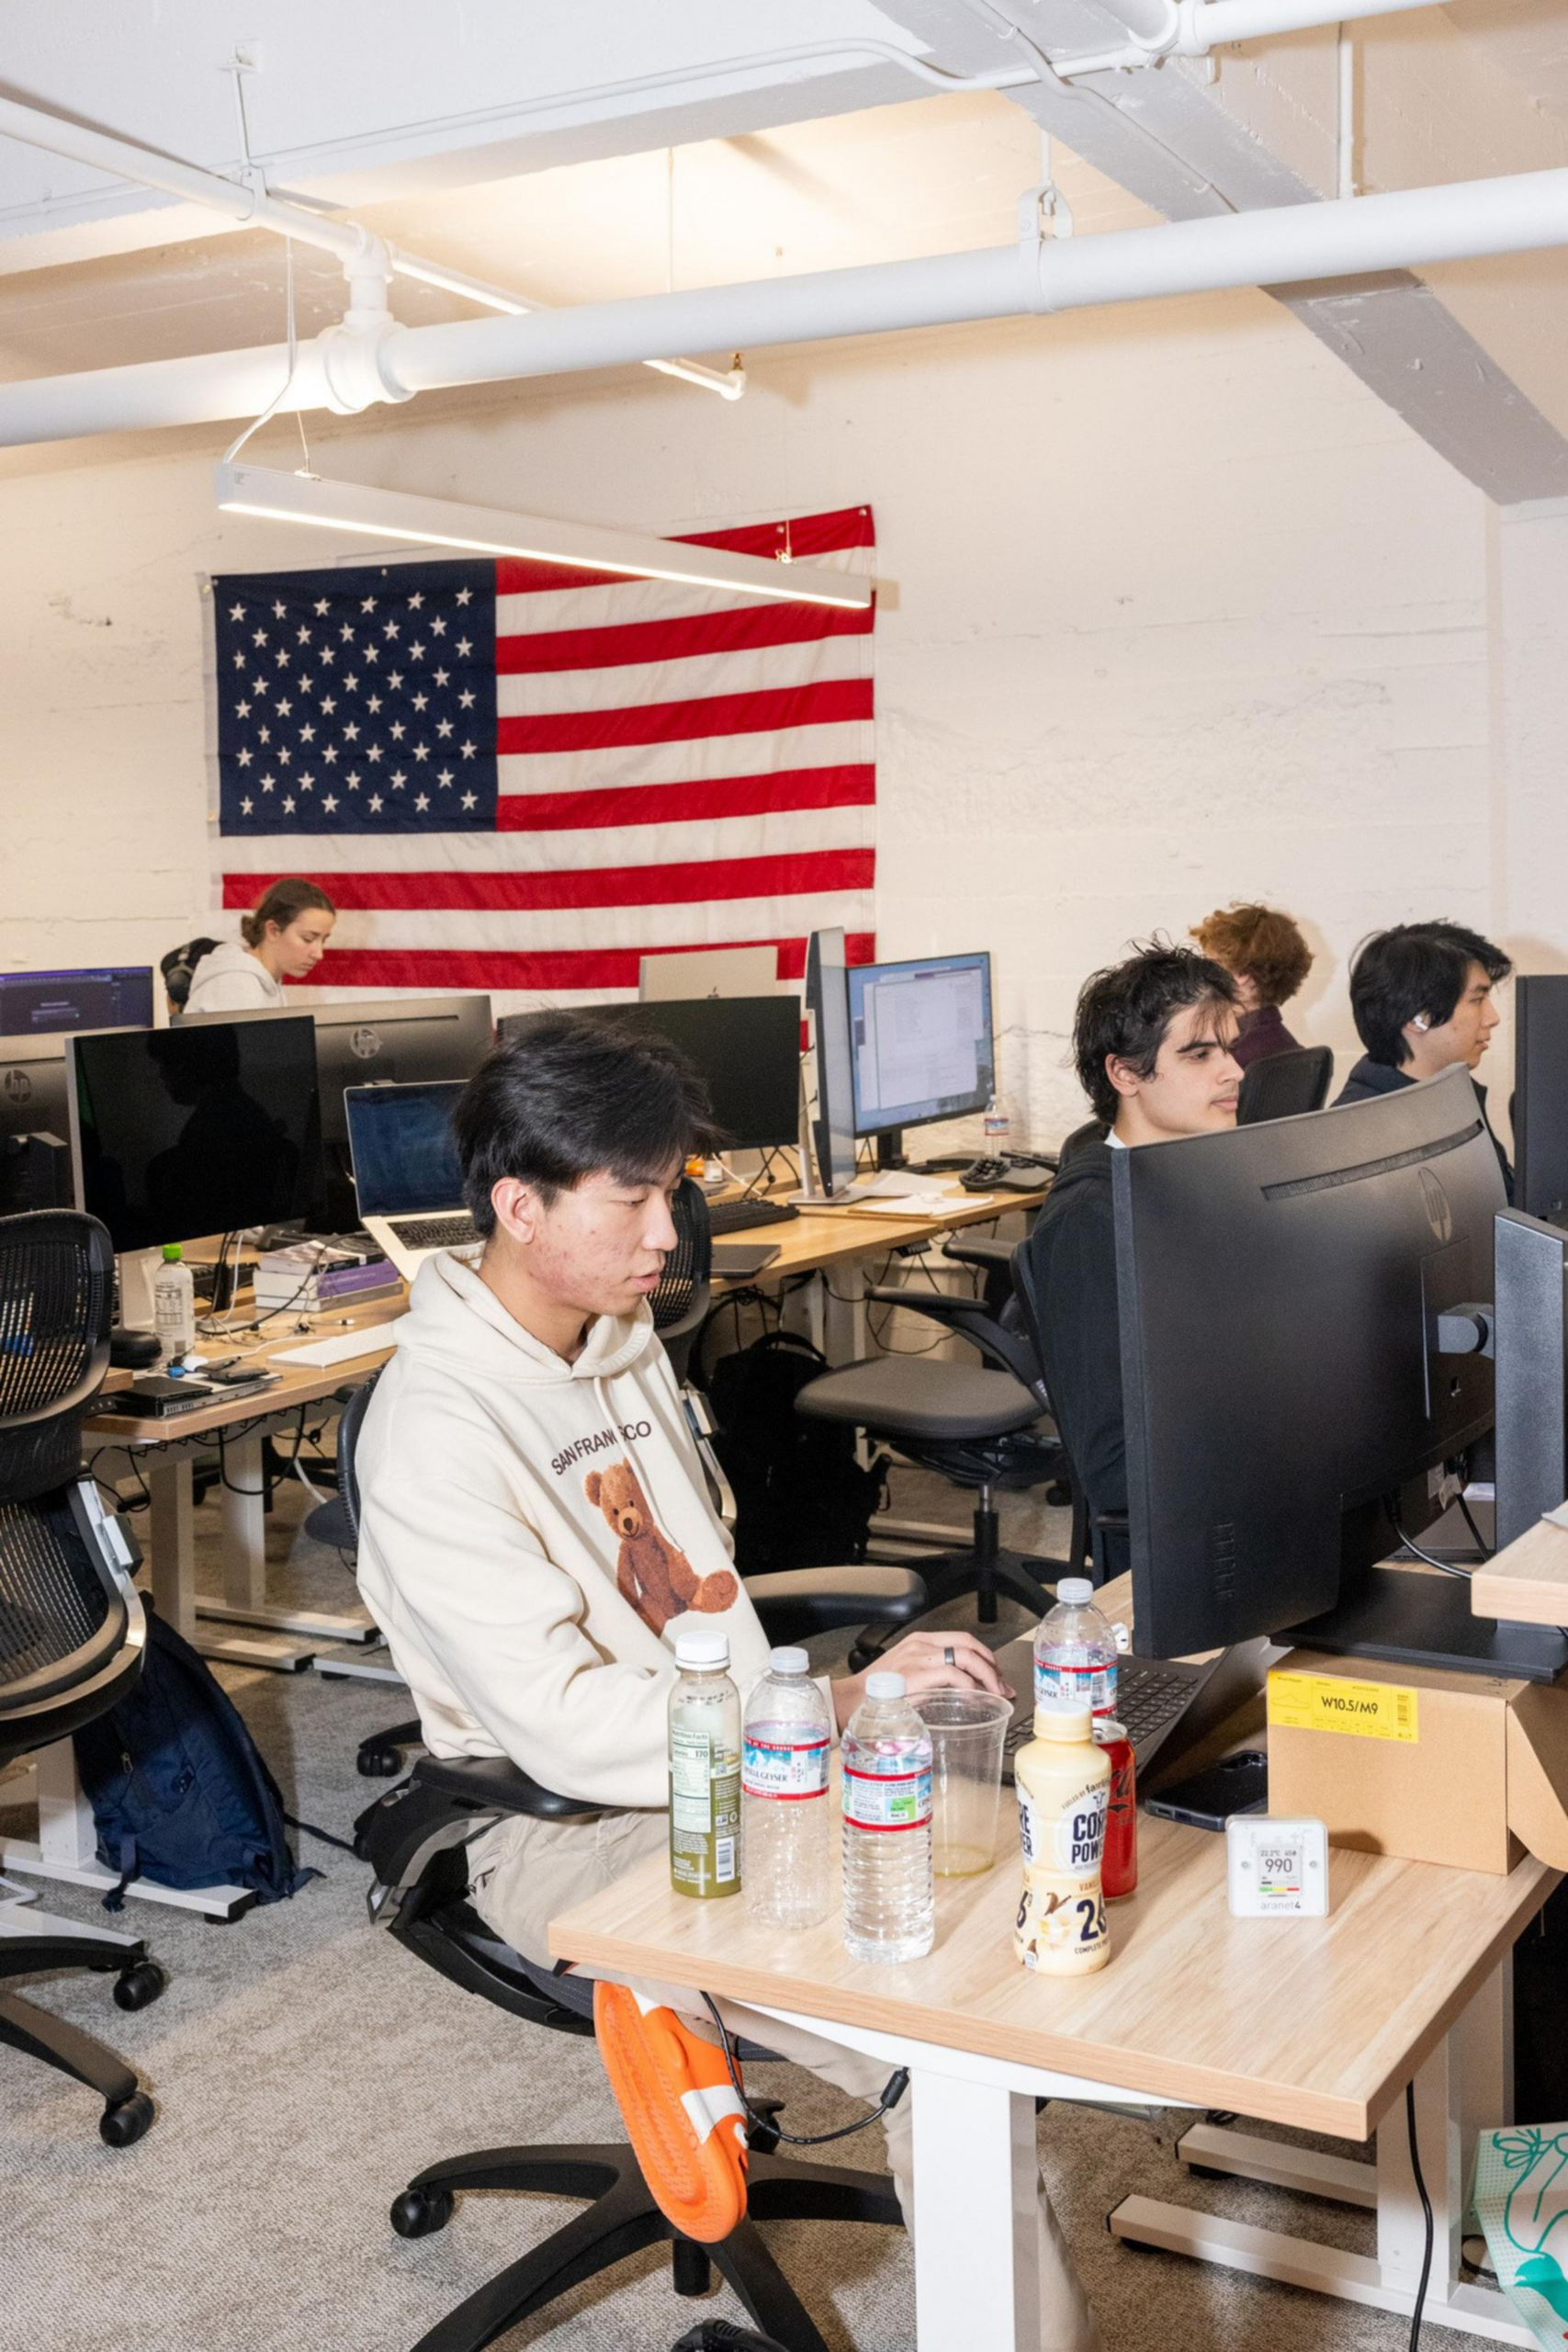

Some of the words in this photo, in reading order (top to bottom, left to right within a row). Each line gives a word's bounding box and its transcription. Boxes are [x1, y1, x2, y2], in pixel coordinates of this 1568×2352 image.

[5, 1069, 32, 1103] hp
[551, 1446, 577, 1476] SAN
[573, 1420, 651, 1459] FRANCO
[1320, 1695, 1378, 1715] W10.5/M9
[695, 1749, 708, 1758] 170
[760, 1771, 788, 1782] GEYSER
[1072, 1807, 1108, 1842] COR
[1265, 1858, 1292, 1873] 990
[1260, 1900, 1301, 1910] aranet4
